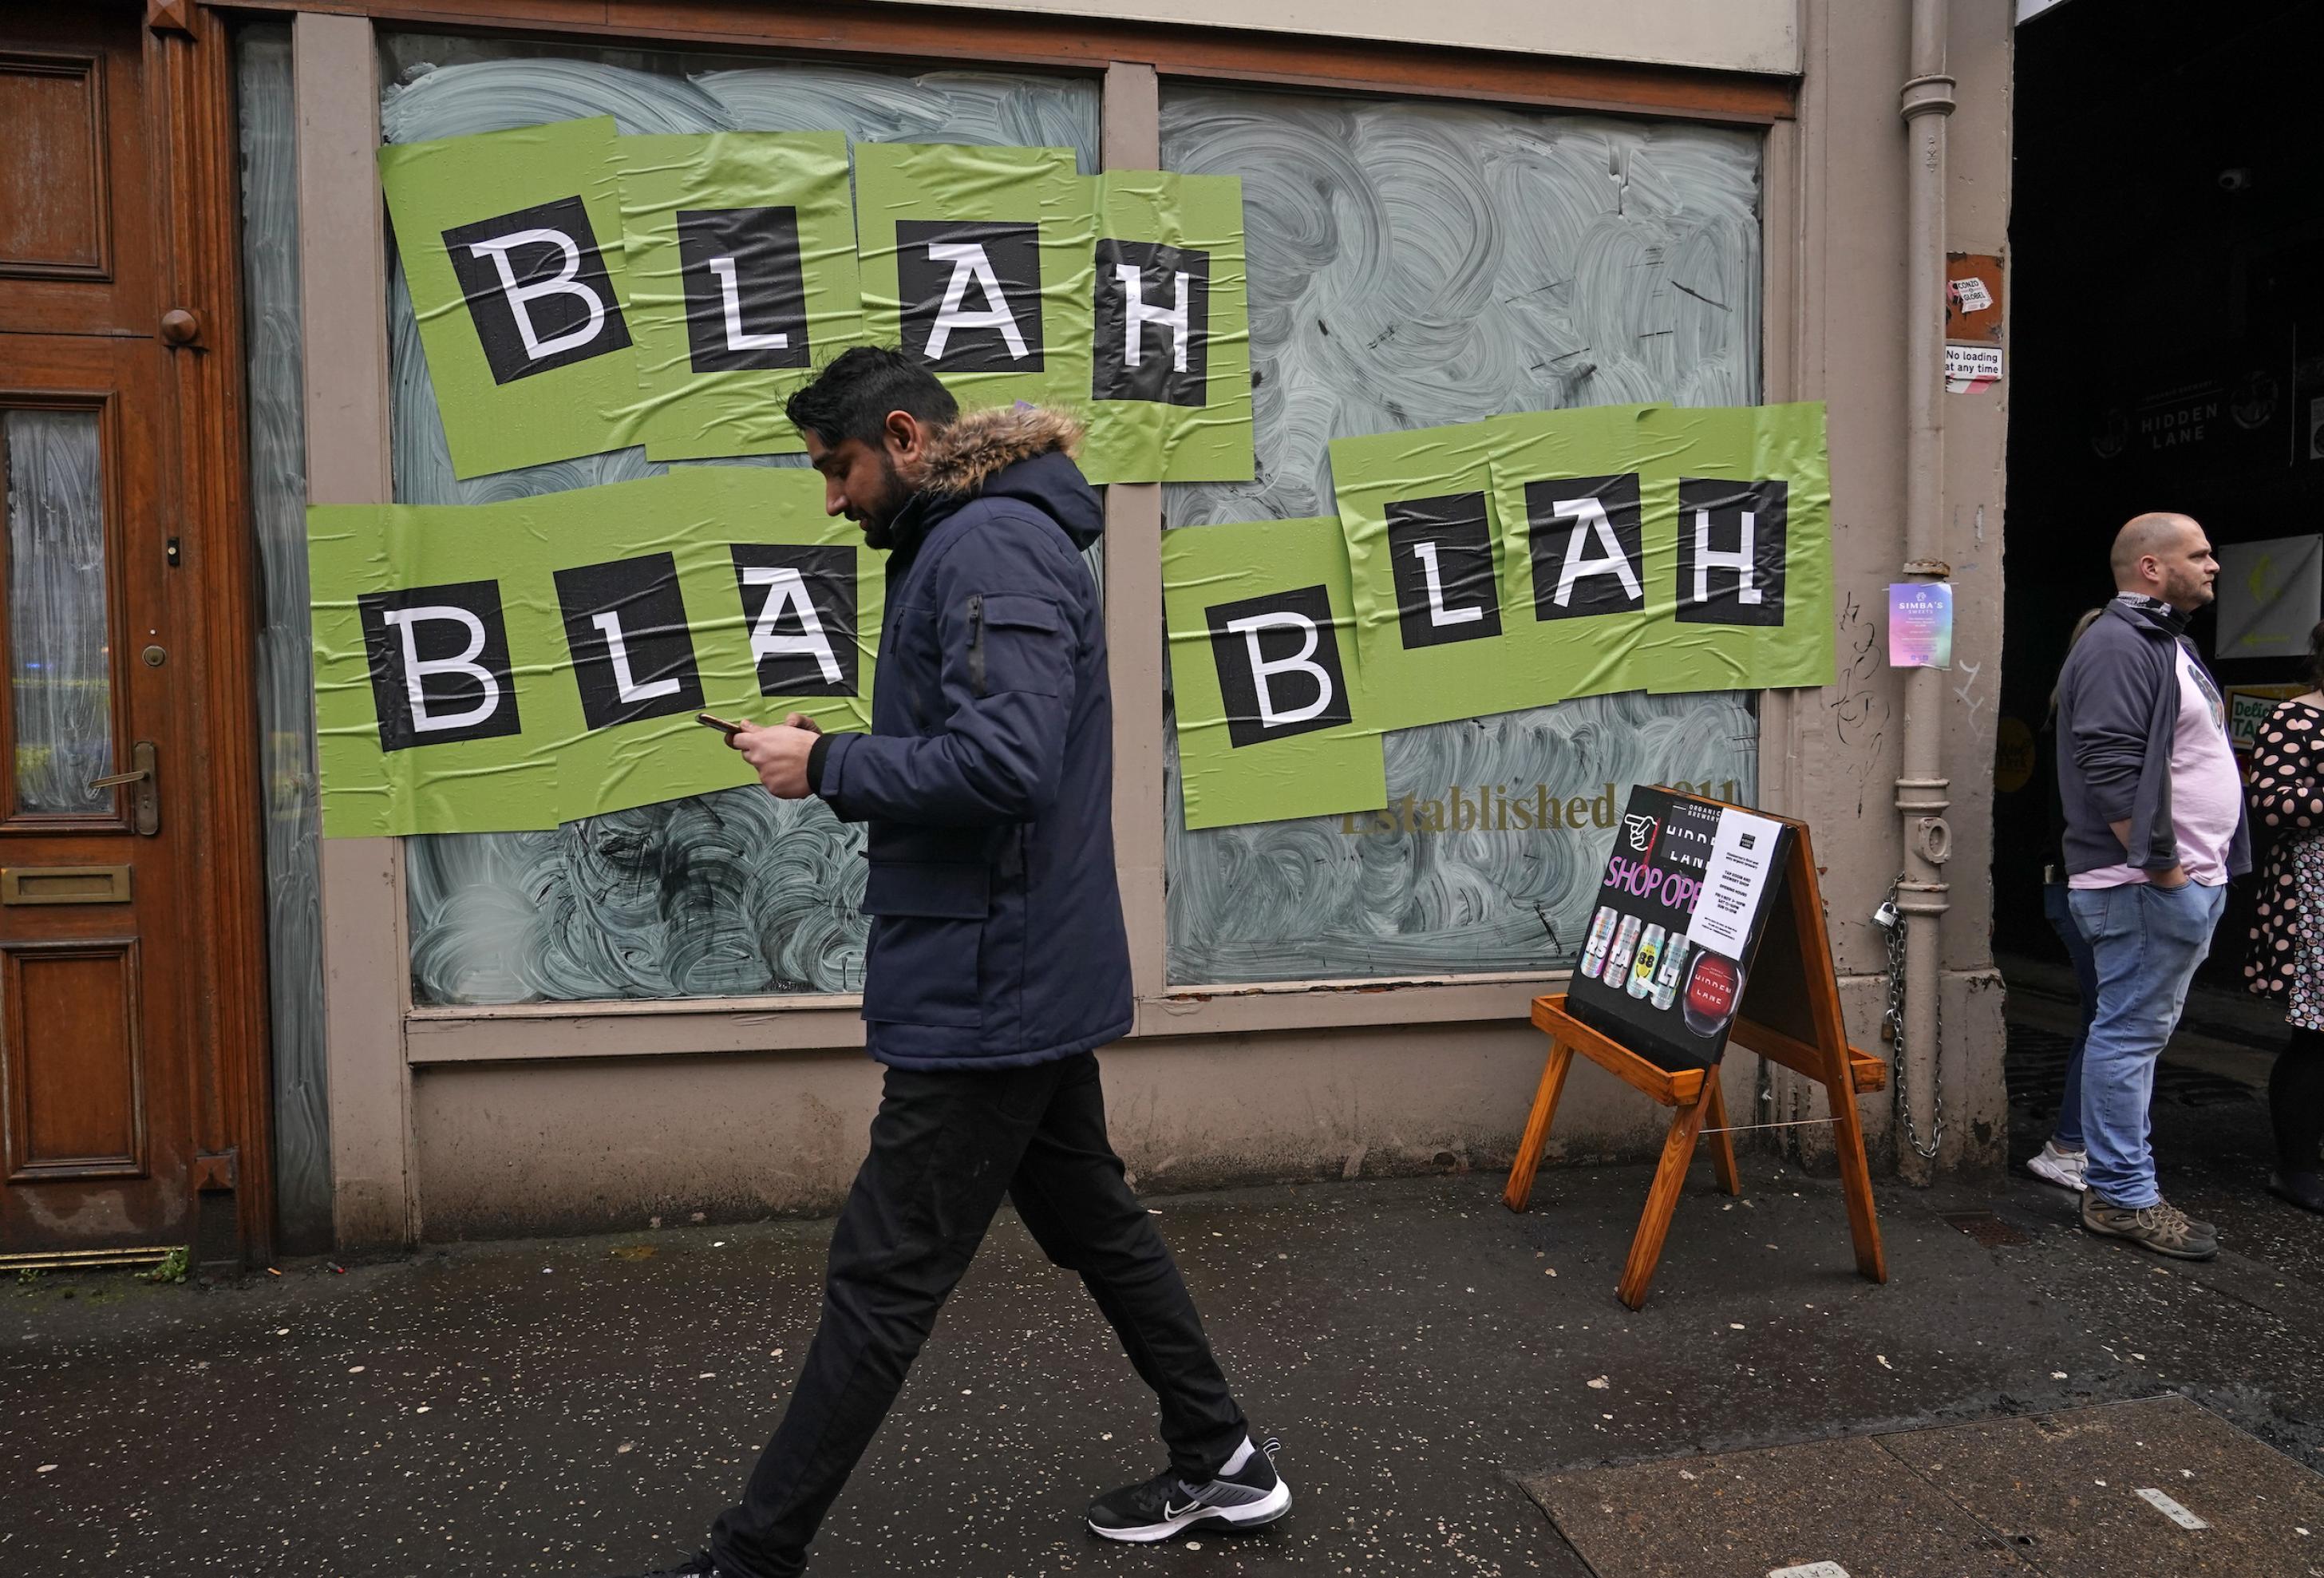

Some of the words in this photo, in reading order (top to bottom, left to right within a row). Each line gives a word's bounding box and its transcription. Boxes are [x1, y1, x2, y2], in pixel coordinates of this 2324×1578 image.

[469, 228, 1190, 374] BLAH
[1947, 350, 1959, 360] No
[1963, 351, 1998, 363] loading
[1958, 365, 1974, 374] any
[1978, 364, 1998, 374] time
[2141, 402, 2218, 433] HIDDEN
[2152, 425, 2205, 450] LANE
[1227, 496, 1762, 730] BLAH
[383, 567, 844, 733] BLA
[2234, 718, 2256, 738] TA
[1687, 810, 1719, 823] BREWERY
[1689, 805, 1721, 817] ORGANIC
[1666, 825, 1716, 846] HIDDE
[1670, 850, 1709, 871] LAN
[1603, 856, 1662, 899] SHOP
[1661, 873, 1703, 914] OPE
[1638, 952, 1654, 967] 88
